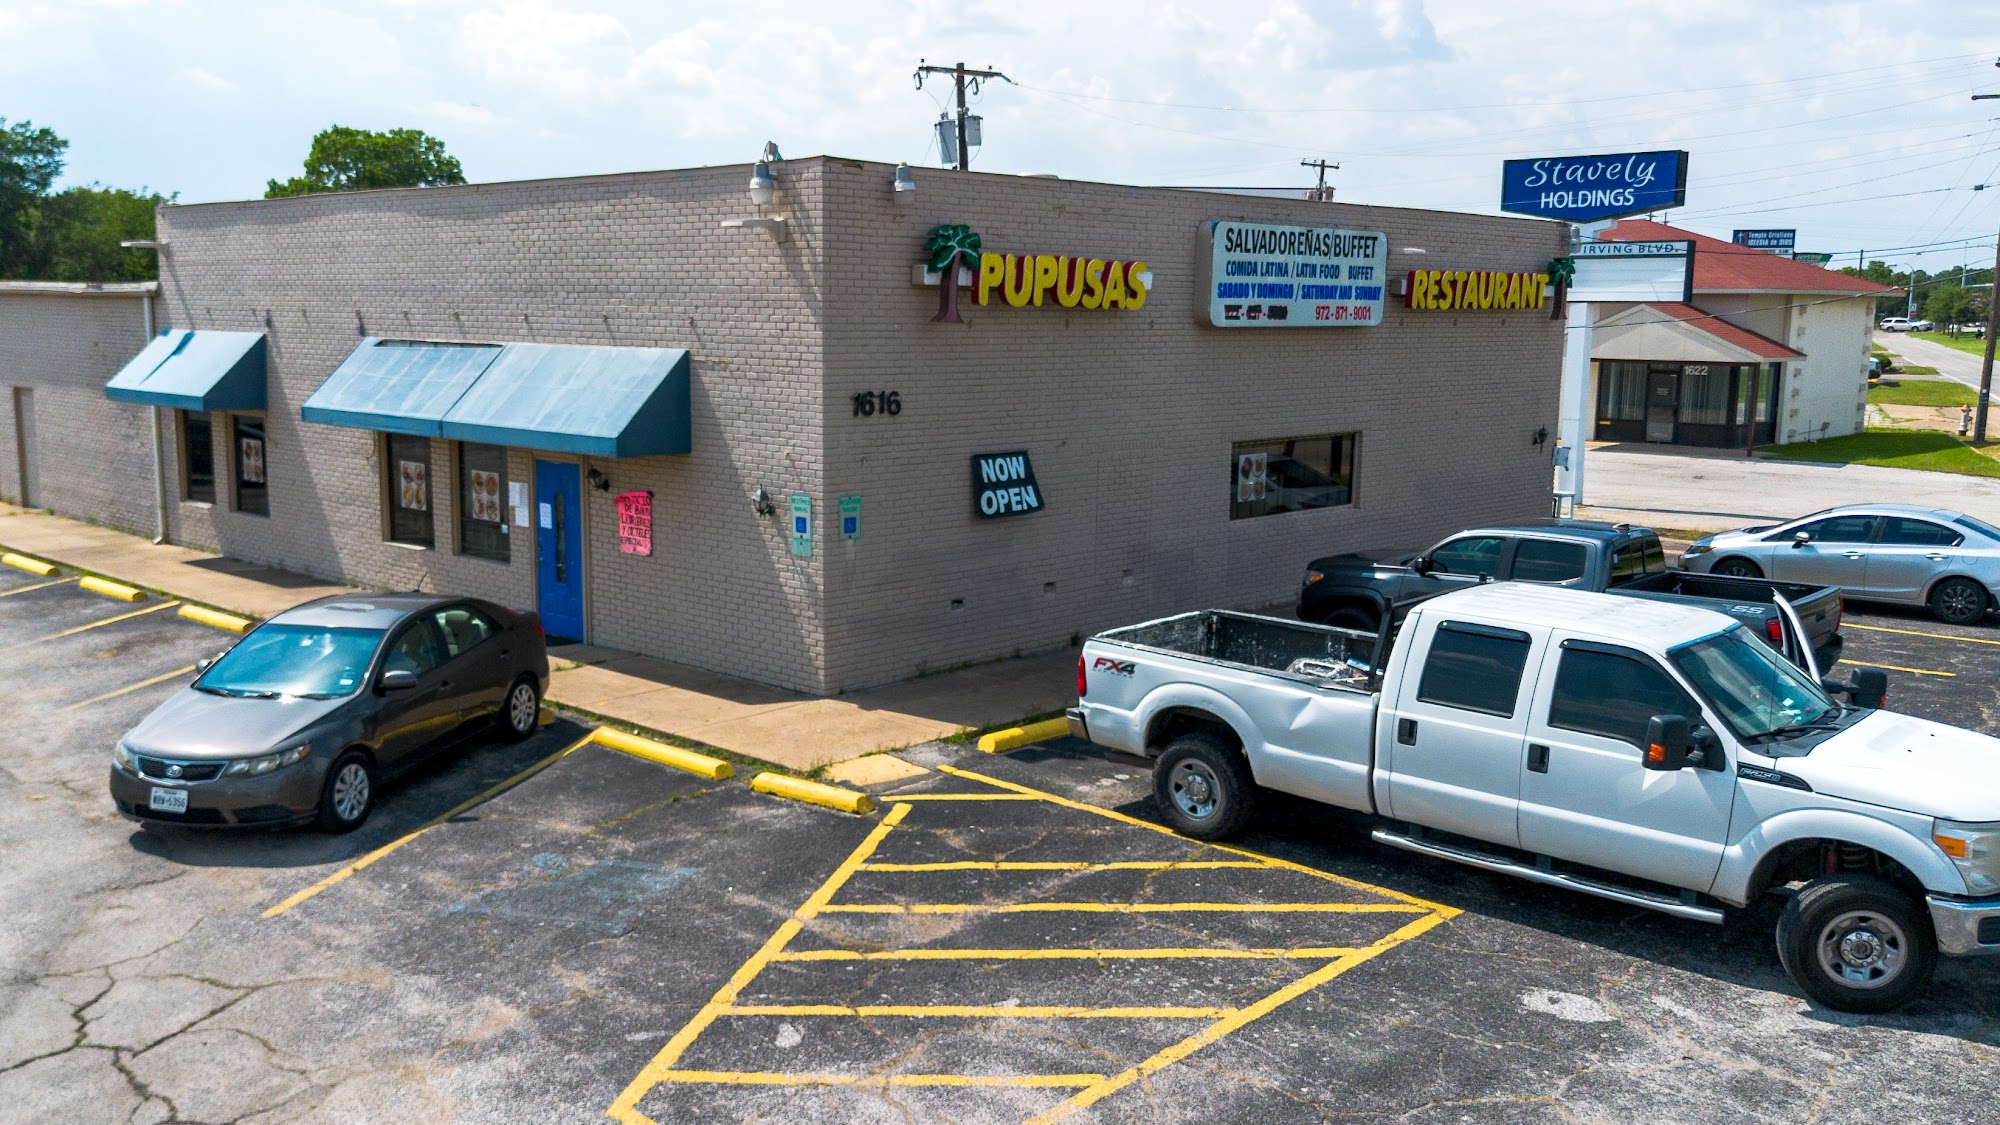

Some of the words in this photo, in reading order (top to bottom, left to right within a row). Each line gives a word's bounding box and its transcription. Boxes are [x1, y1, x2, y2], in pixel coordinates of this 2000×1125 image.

[1524, 155, 1657, 188] Stavely
[1540, 188, 1635, 209] HOLDINGS
[1583, 245, 1633, 254] IRVING
[1638, 244, 1680, 253] BLVD.
[977, 252, 1147, 311] PUPUSAS
[1226, 260, 1258, 277] COMIDA
[1260, 261, 1289, 278] LATINA
[1296, 262, 1318, 278] LATIN
[1319, 264, 1340, 279] FOOD
[1348, 265, 1374, 281] BUFFET
[1217, 282, 1250, 299] SABADO
[1257, 283, 1294, 299] DOMINGO
[1301, 284, 1339, 300] SATURDAY
[1354, 286, 1382, 301] SUNDAY
[1411, 269, 1550, 310] RESTAURANT
[1684, 365, 1708, 376] 1622
[851, 390, 902, 417] 1616
[980, 456, 1026, 483] NOW
[980, 486, 1039, 515] OPEN
[1094, 657, 1136, 675] FX4
